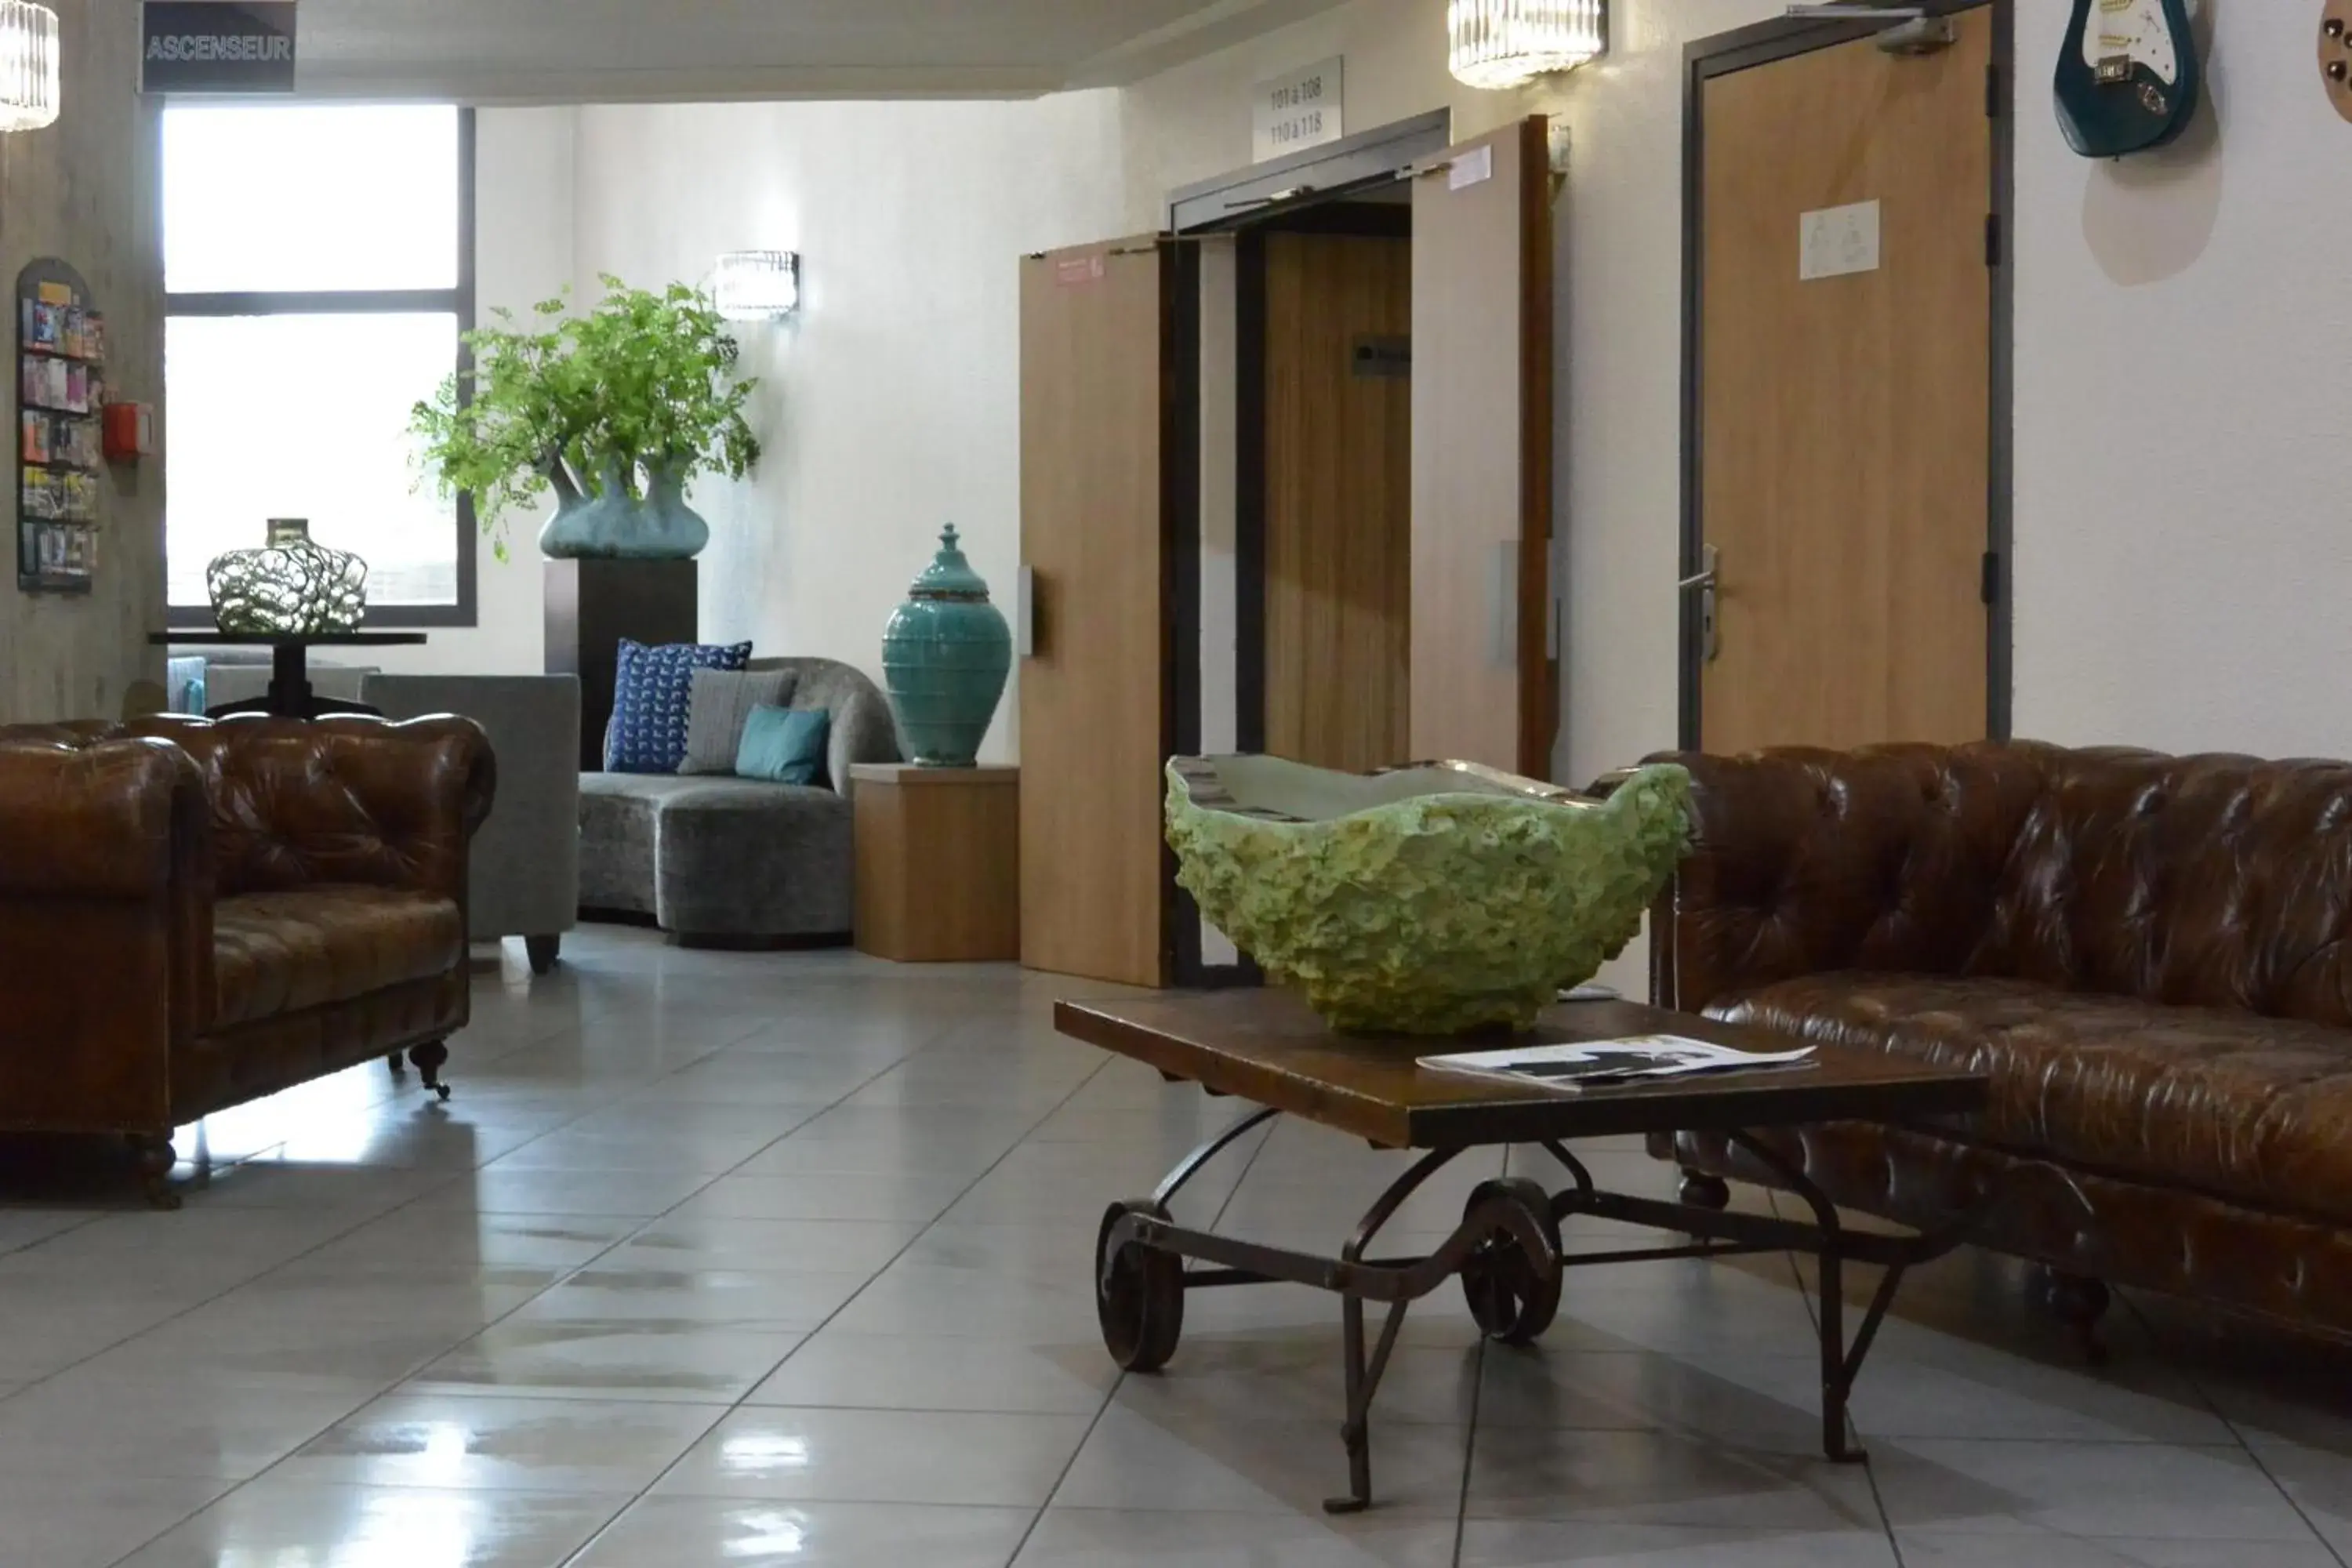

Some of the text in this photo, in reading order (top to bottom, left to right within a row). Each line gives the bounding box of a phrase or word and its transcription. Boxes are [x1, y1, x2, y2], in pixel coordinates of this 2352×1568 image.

[147, 35, 291, 61] ASCENSEUR
[1271, 87, 1289, 111] 101
[1271, 122, 1290, 144] 110
[1301, 111, 1323, 136] 118
